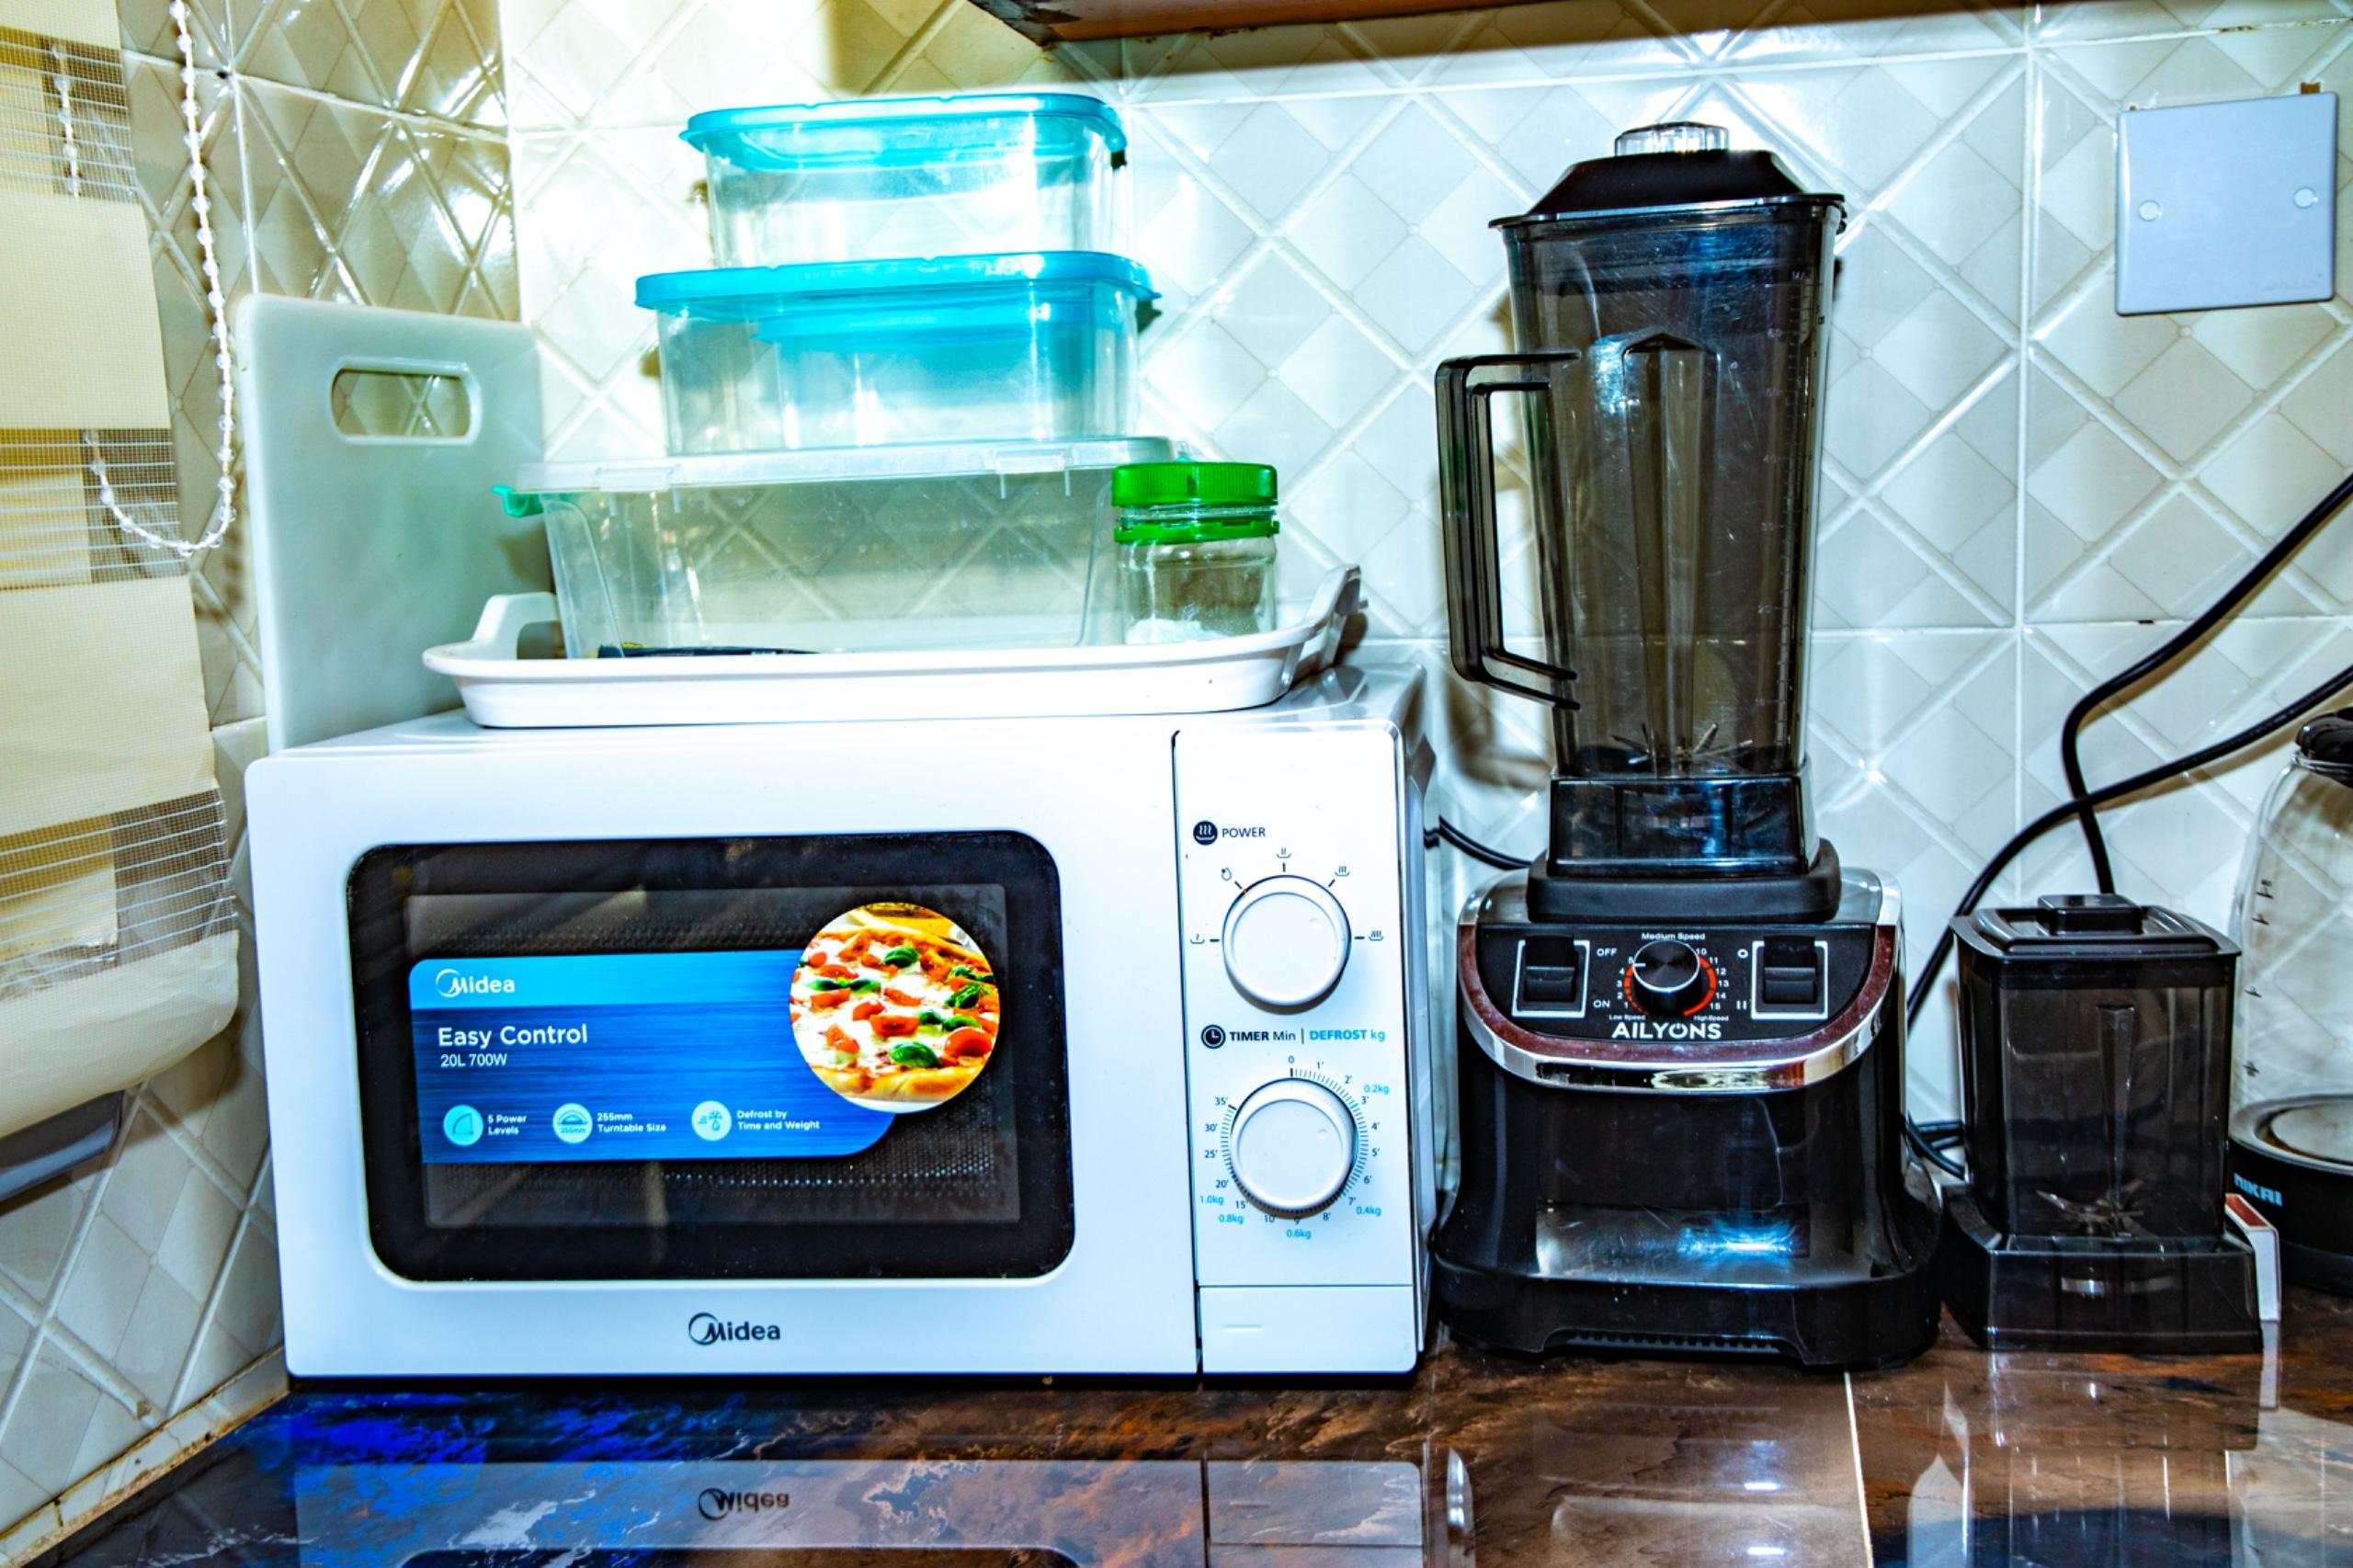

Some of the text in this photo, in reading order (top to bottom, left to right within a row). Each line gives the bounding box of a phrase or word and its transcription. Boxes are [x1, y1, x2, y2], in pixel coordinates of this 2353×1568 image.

[1222, 827, 1266, 838] POWER
[1642, 932, 1705, 941] Medium Speed
[1597, 948, 1618, 957] OFF
[1697, 948, 1707, 956] 10
[1709, 956, 1719, 964] 11
[1619, 967, 1625, 975] 4
[1716, 968, 1727, 976] 12
[435, 969, 516, 998] Midea
[1616, 979, 1623, 987] 3
[1718, 979, 1729, 987] 13
[1617, 992, 1623, 1000] 2
[1716, 992, 1726, 1000] 14
[1593, 999, 1610, 1008] ON
[1611, 1021, 1722, 1040] AILYONS
[438, 1023, 588, 1050] Easy Control
[1230, 1028, 1386, 1043] TIMER Min DEFROST kg
[440, 1053, 507, 1068] 20L 700W
[1288, 1056, 1295, 1064] 0
[1364, 1085, 1390, 1095] 0.2kg
[488, 1115, 527, 1123] 5 Power
[597, 1112, 632, 1121] 255mm
[737, 1109, 787, 1120] Defrost by
[597, 1123, 666, 1133] Turntable Size
[738, 1120, 820, 1131] Time and Weight
[488, 1126, 518, 1135] Levels
[1200, 1195, 1223, 1206] 1.0kg
[1356, 1206, 1381, 1217] 0.4kg
[1219, 1214, 1244, 1224] 0.8kg
[1287, 1229, 1312, 1240] 0.6kg
[688, 1312, 781, 1346] Midea
